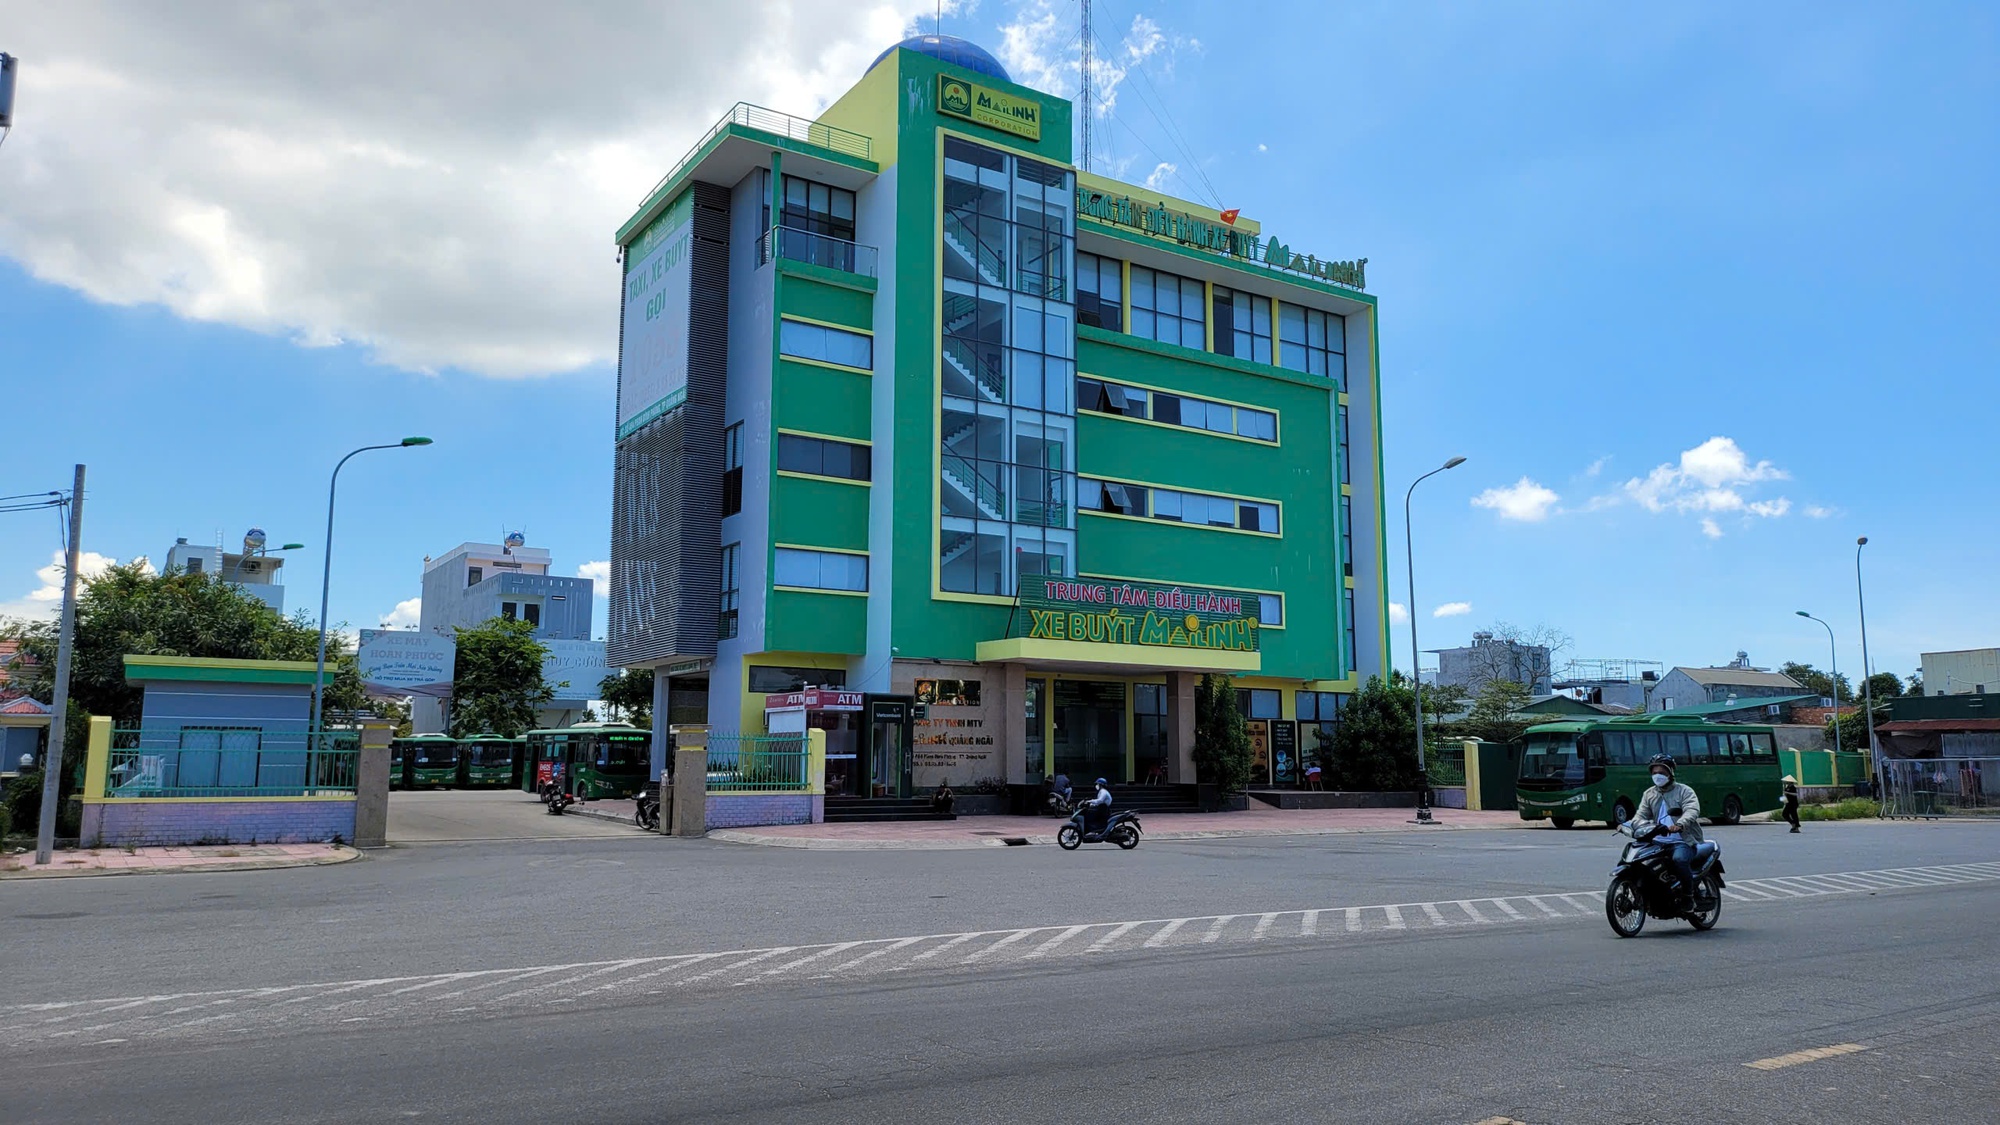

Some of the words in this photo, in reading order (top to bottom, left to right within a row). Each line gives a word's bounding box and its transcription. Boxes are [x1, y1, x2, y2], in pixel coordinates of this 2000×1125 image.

[977, 114, 1037, 137] CORPORATION
[1079, 187, 1112, 220] RUNG
[1115, 195, 1141, 228] TÂM
[1146, 201, 1172, 237] ĐIỀU
[1176, 212, 1208, 246] HÀNH
[1211, 224, 1227, 250] XE
[651, 256, 662, 286] XE
[665, 233, 689, 273] BUÝT
[646, 287, 667, 321] GỌI
[1045, 581, 1105, 604] TRUNG
[1111, 584, 1149, 606] TÂM
[1156, 587, 1191, 611] ĐIỀU
[1196, 591, 1241, 613] HÀNH
[1030, 610, 1065, 640] XE
[1069, 608, 1135, 644] BUÝT
[574, 655, 606, 668] CƯỜN
[838, 694, 861, 705] ATM
[967, 719, 983, 728] MTV
[975, 735, 993, 745] NGÃI
